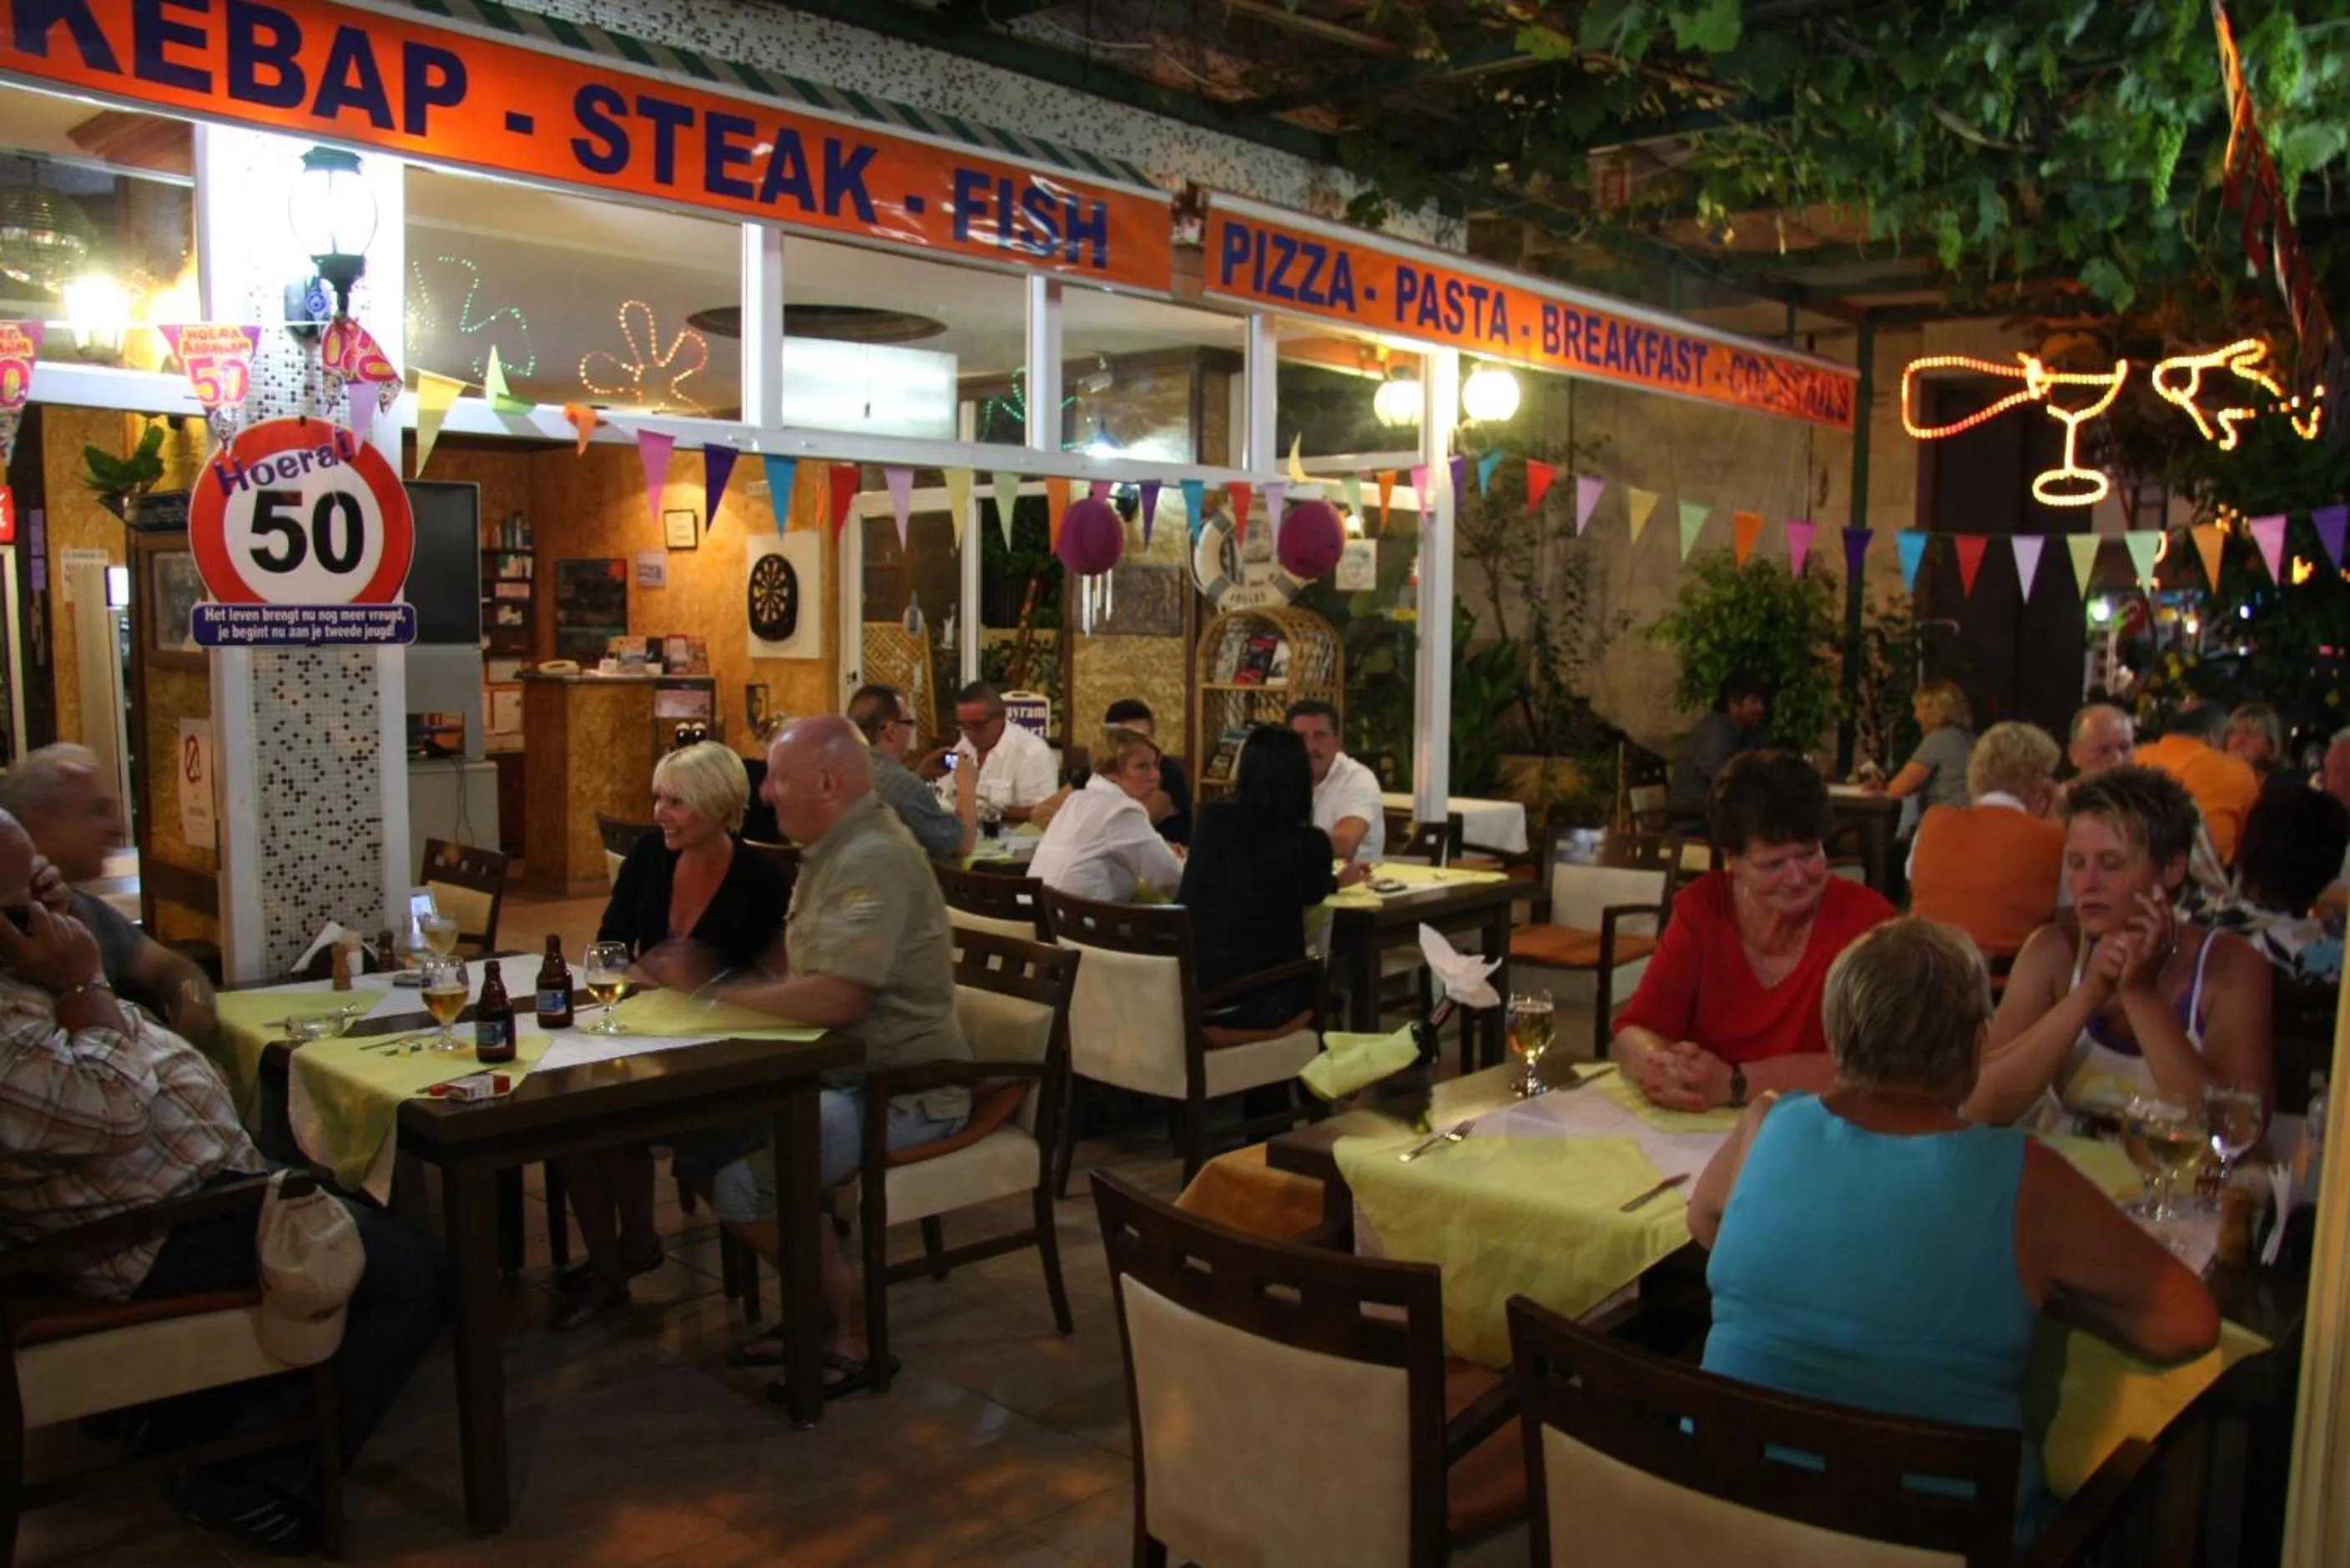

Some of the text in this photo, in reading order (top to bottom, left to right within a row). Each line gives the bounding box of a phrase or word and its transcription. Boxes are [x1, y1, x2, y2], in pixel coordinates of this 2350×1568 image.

[10, 0, 467, 137] KEBAP
[570, 83, 880, 225] STEAK
[953, 168, 1108, 270] FISH
[1221, 221, 1356, 313] PIZZA
[1395, 264, 1510, 345] PASTA
[1541, 302, 1707, 390] BREAKFAST
[188, 357, 250, 403] 50
[214, 426, 354, 497] Hoera!
[250, 489, 365, 575] 50
[204, 608, 225, 622] Het
[229, 608, 260, 622] leven
[262, 608, 300, 625] brengt
[301, 610, 316, 622] nu
[318, 610, 338, 625] nog
[340, 610, 366, 622] meer
[218, 623, 230, 643] je
[231, 624, 269, 642] begint
[271, 627, 286, 638] nu
[289, 627, 310, 638] aan
[310, 623, 322, 641] je
[325, 623, 363, 638] tweede
